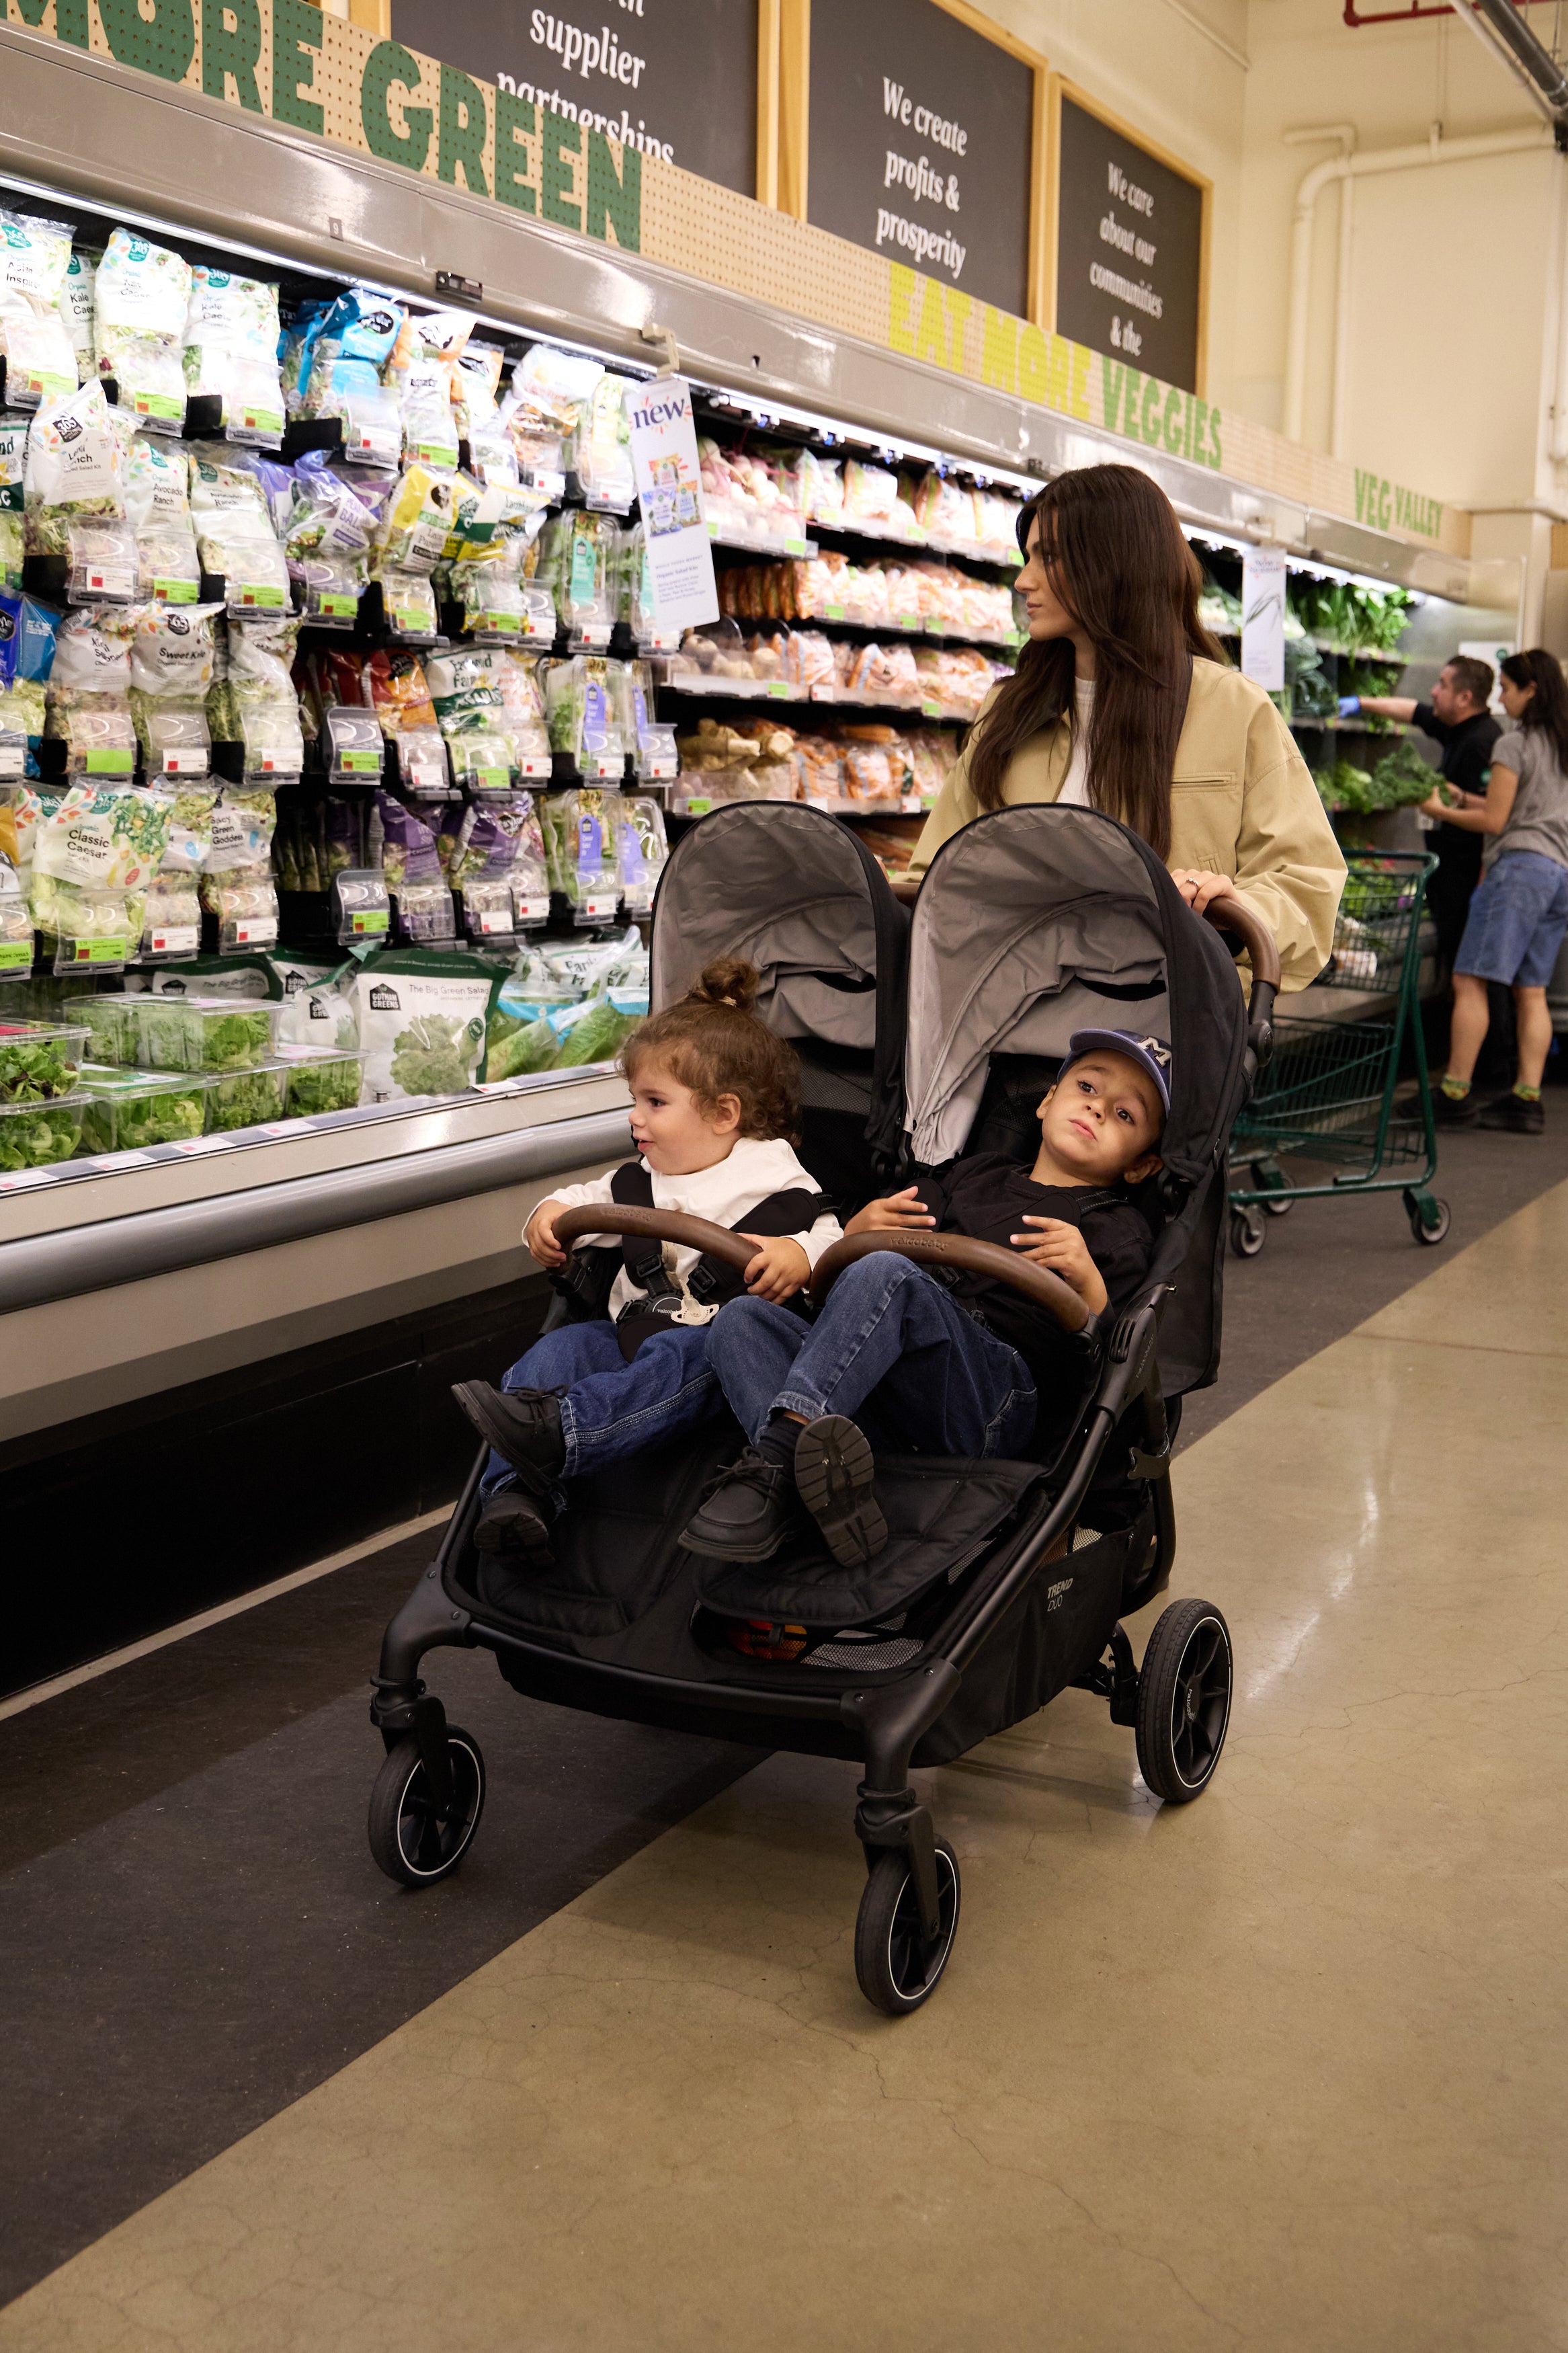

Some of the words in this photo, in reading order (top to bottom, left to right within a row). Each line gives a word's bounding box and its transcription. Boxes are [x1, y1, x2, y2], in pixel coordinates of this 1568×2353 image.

[530, 9, 646, 89] supplier
[882, 76, 913, 126] We
[913, 105, 968, 157] create
[361, 40, 641, 253] GREEN
[884, 150, 944, 203] profits
[945, 174, 960, 212] &
[1108, 161, 1128, 201] We
[333, 223, 339, 235] 9
[876, 207, 966, 279] prosperity
[70, 292, 89, 303] Kale
[889, 260, 972, 374] EAT
[981, 304, 1092, 422] MORE
[1102, 353, 1223, 470] VEGGIES
[633, 398, 685, 429] new
[153, 483, 183, 496] Avocado
[153, 494, 175, 506] Ranch
[1354, 467, 1391, 531] VEG
[1395, 485, 1444, 539] VALLEY
[159, 647, 190, 660] Sweet
[69, 830, 110, 848] Classic
[212, 826, 235, 835] Green
[67, 841, 108, 859] Caesar
[372, 992, 397, 1001] GOTHAM
[409, 984, 423, 994] The
[426, 985, 438, 996] Big
[440, 986, 466, 995] Green
[372, 1000, 399, 1008] GREENS
[1137, 1036, 1172, 1068] M
[1047, 1577, 1074, 1599] TREND
[1047, 1594, 1063, 1612] DUO
